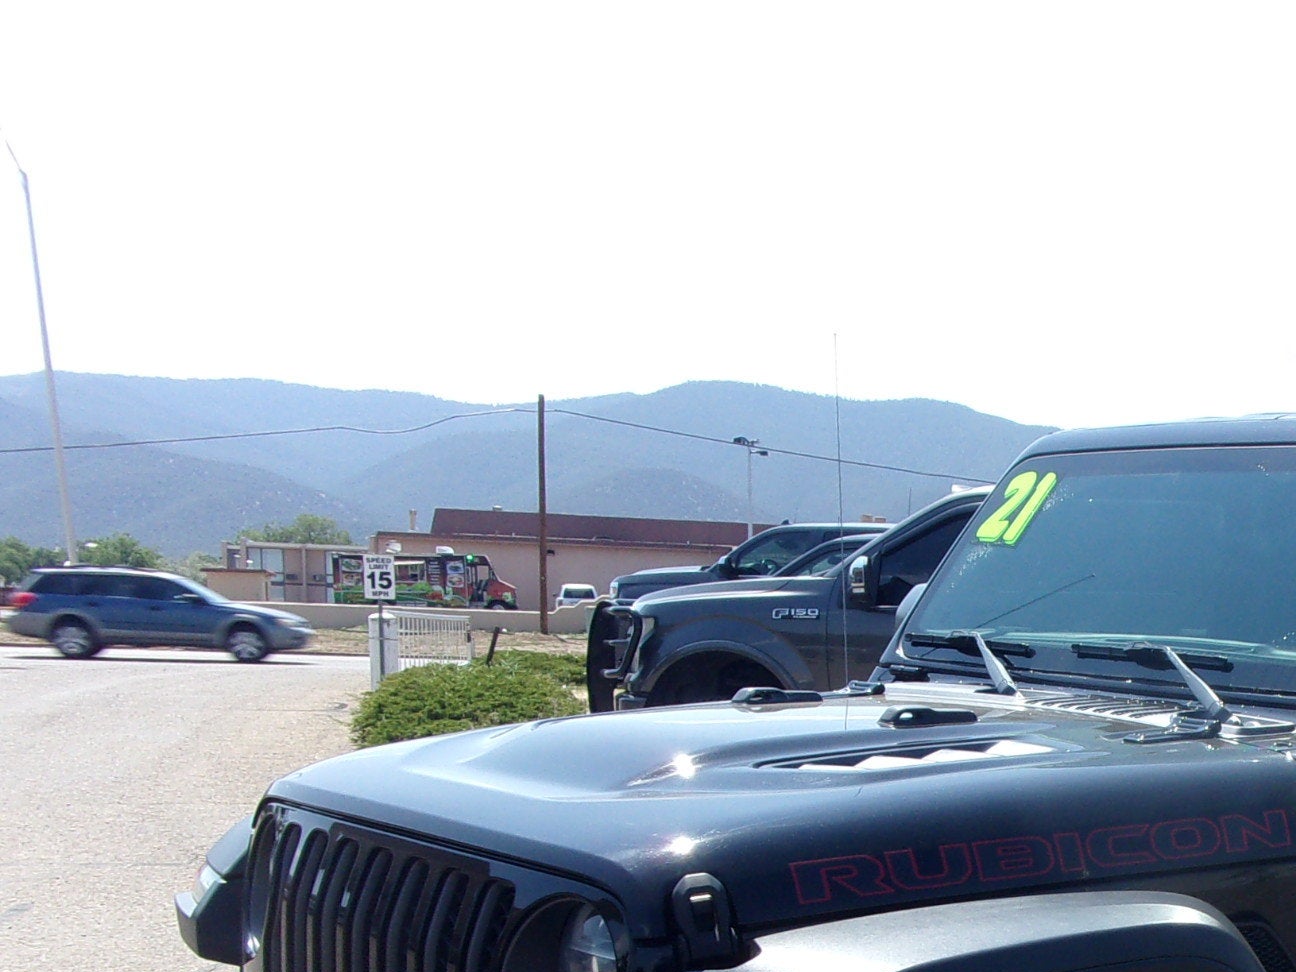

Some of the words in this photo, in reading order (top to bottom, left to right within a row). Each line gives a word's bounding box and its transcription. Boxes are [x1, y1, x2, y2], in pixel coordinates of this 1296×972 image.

[976, 471, 1057, 545] 21
[366, 571, 392, 590] 15
[788, 809, 1291, 905] RUBICON
